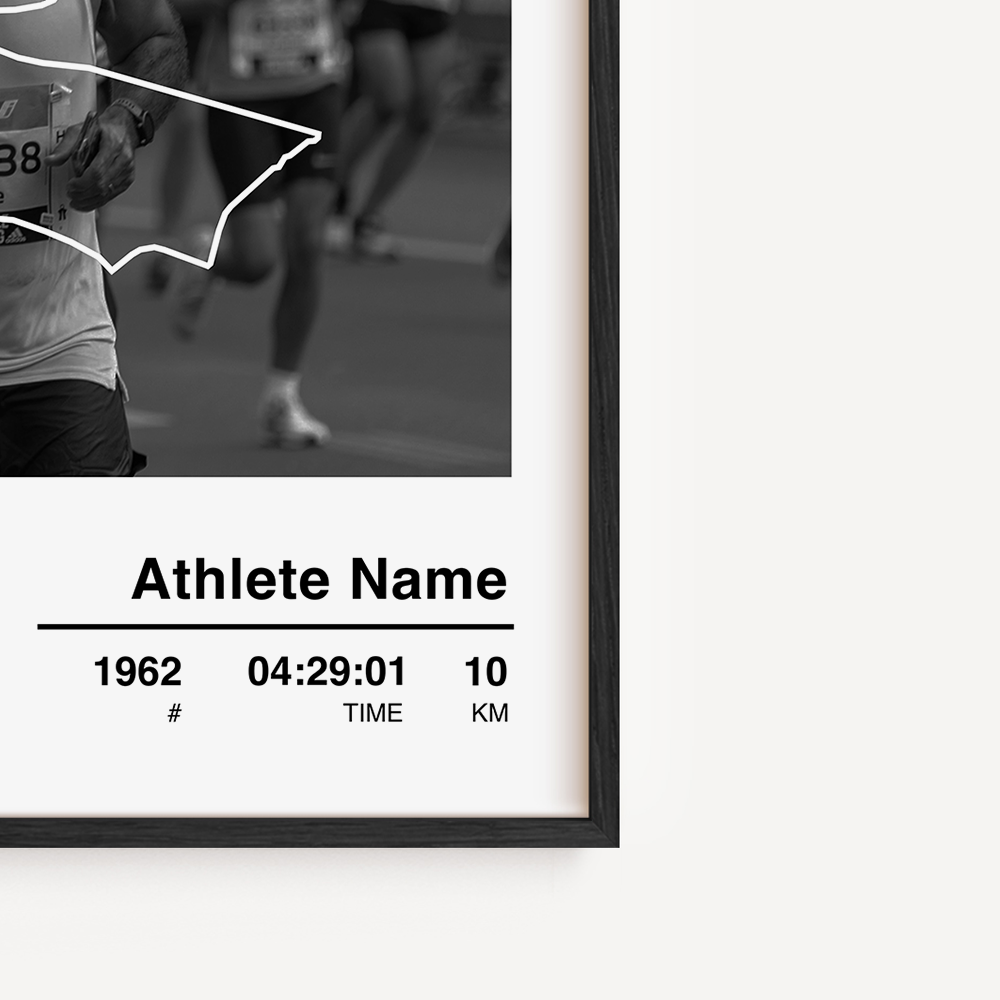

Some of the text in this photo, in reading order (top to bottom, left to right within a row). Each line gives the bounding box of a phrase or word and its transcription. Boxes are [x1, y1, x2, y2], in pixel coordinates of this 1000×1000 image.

[132, 557, 507, 600] Athlete Name
[95, 655, 182, 687] 1962
[248, 655, 403, 687] 04:29:01
[465, 655, 508, 687] 10
[167, 702, 183, 723] #
[343, 702, 403, 723] TIME
[472, 702, 508, 723] KM
